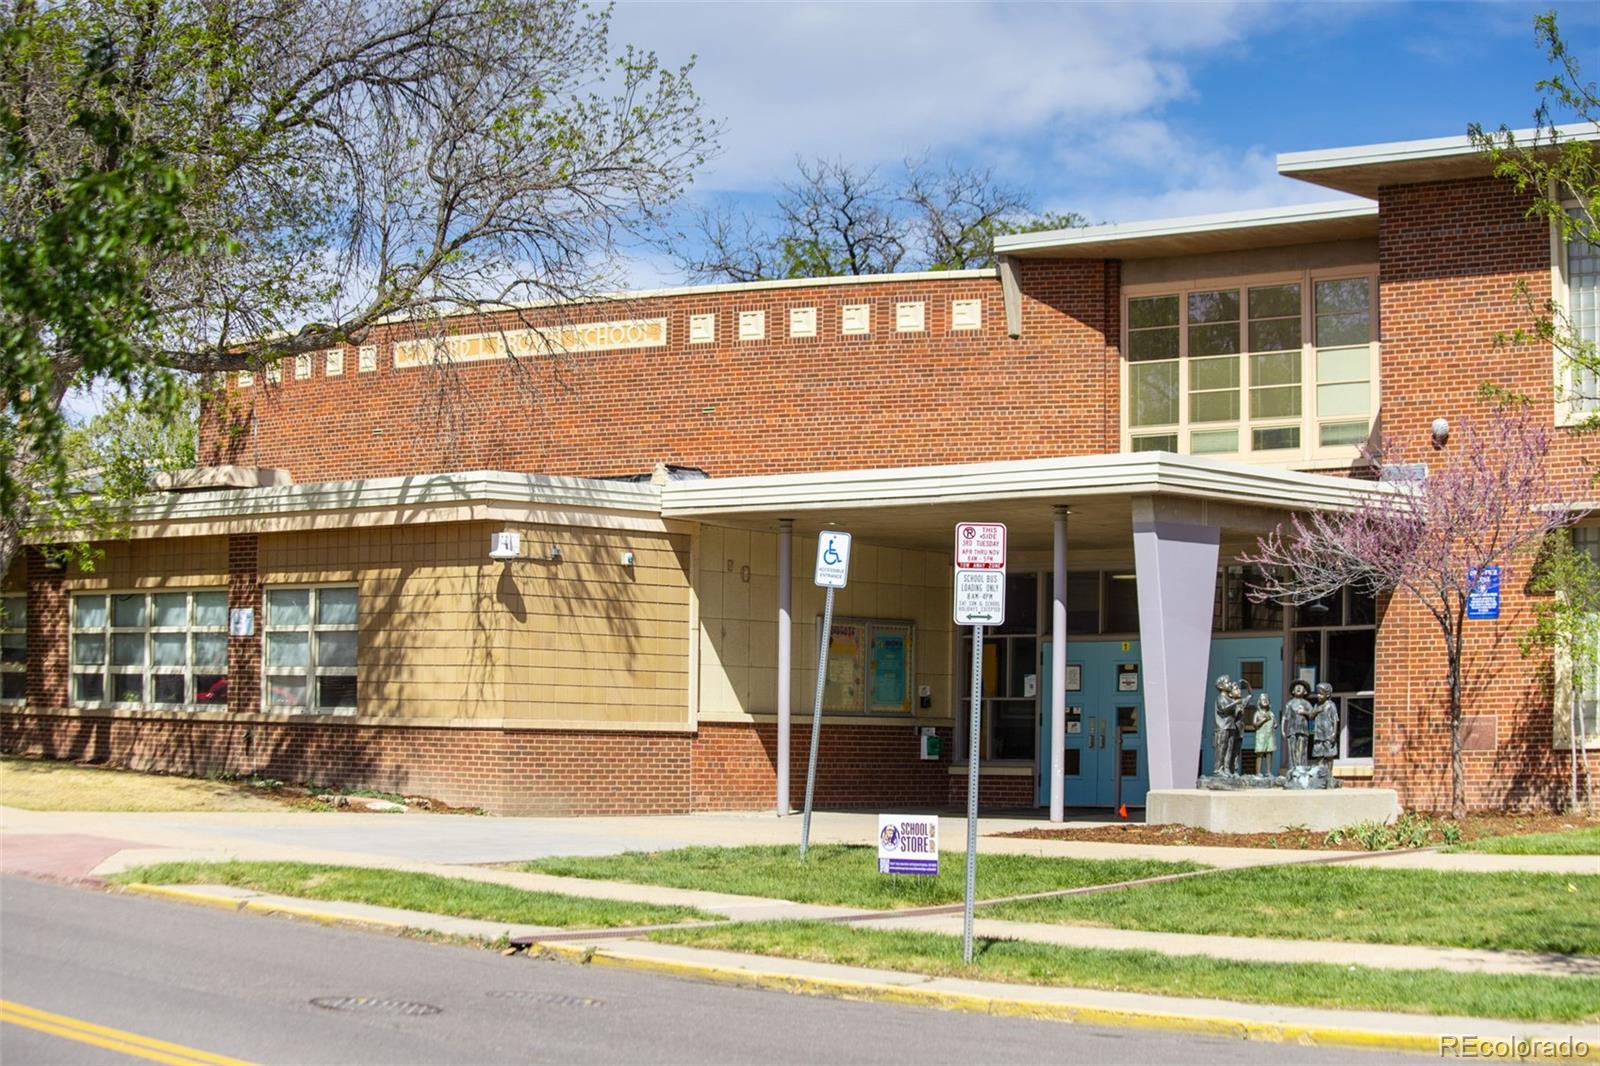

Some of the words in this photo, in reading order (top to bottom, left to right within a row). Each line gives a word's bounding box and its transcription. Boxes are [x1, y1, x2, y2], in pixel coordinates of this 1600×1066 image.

[578, 323, 653, 348] SCHOOL
[964, 574, 984, 582] SCHOOL
[986, 574, 998, 583] BUS
[961, 584, 982, 592] LOADING
[986, 584, 998, 592] ONLY
[900, 822, 928, 836] SCHOOL
[900, 836, 928, 853] STORE
